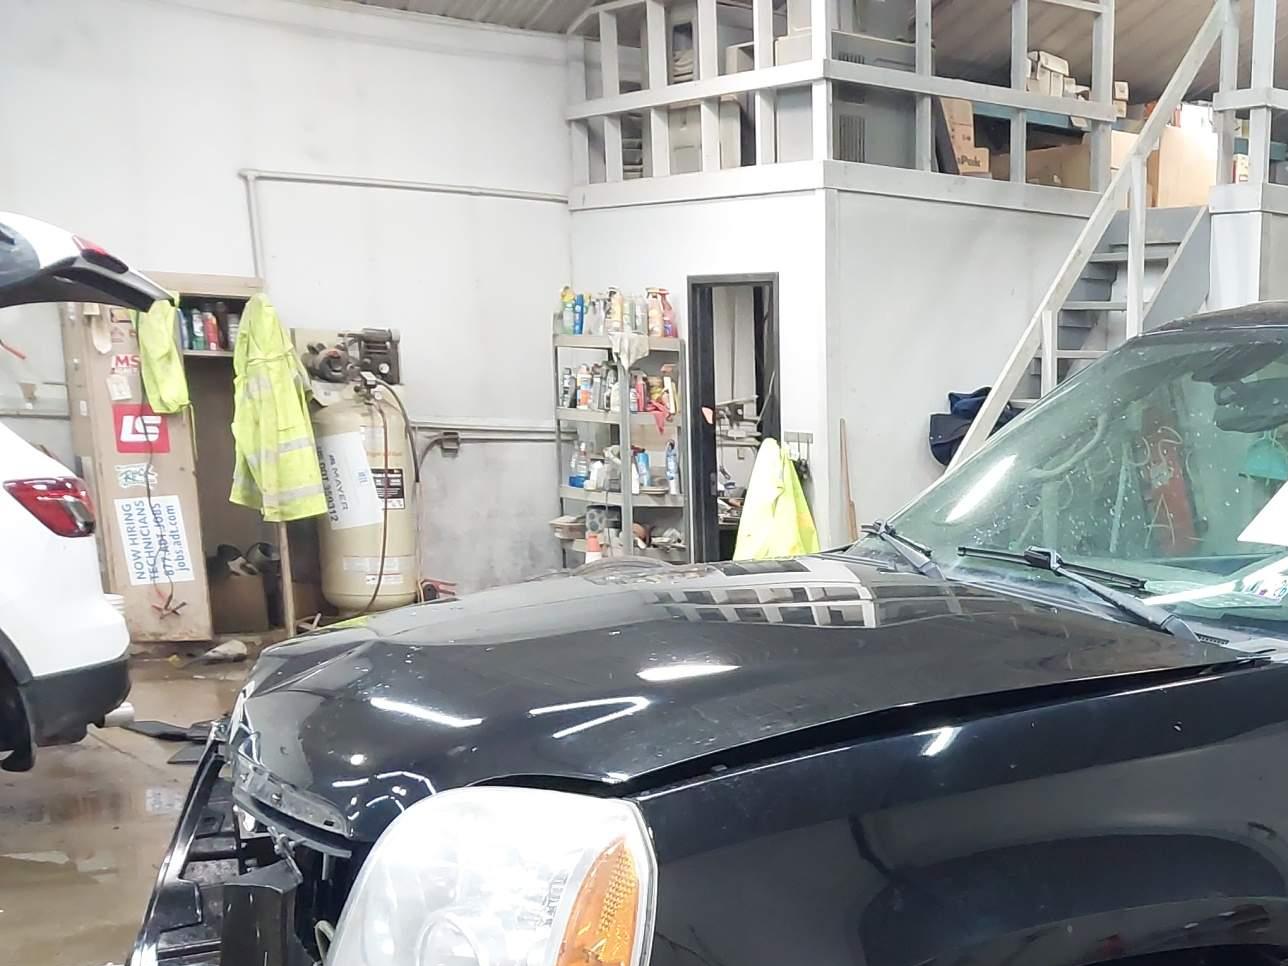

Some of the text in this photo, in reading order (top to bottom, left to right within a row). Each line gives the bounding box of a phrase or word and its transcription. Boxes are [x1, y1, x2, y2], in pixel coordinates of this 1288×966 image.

[121, 503, 147, 580] NOW HIRING
[134, 500, 160, 581] TECHNICIANS
